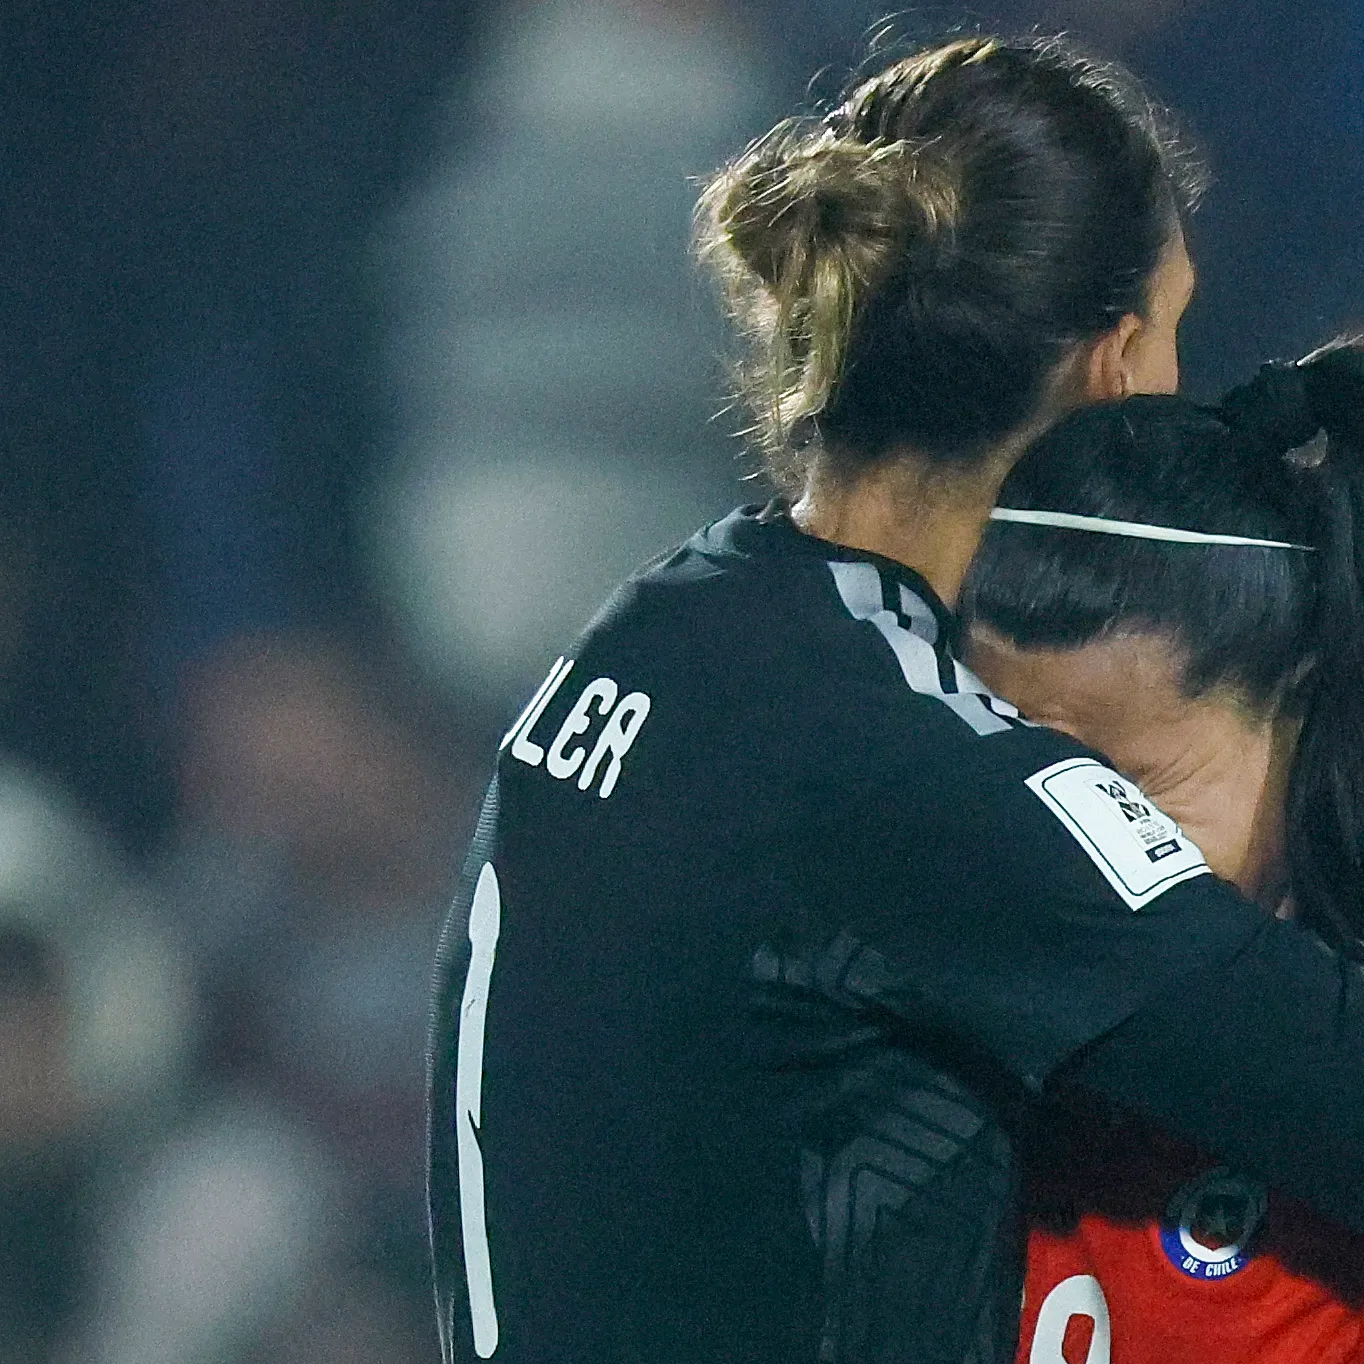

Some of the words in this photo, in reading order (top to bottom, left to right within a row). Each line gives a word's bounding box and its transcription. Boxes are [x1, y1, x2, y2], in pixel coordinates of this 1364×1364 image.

[499, 656, 651, 799] LER
[456, 861, 501, 1360] 1
[1182, 1256, 1201, 1274] DE
[1205, 1257, 1239, 1277] CHILE
